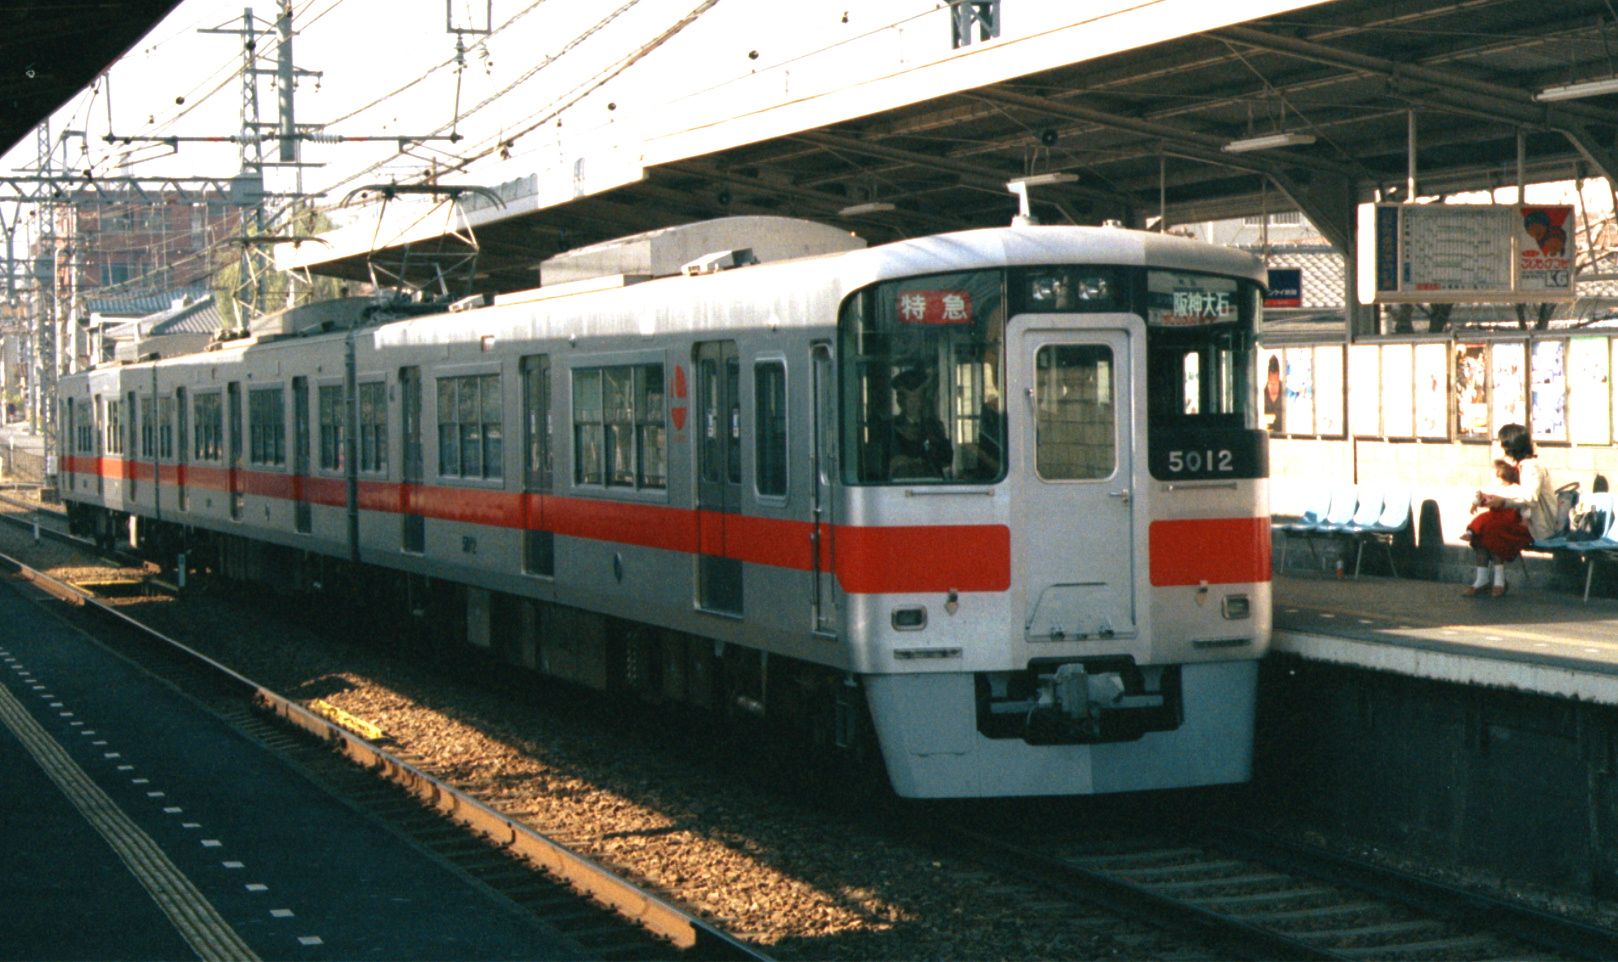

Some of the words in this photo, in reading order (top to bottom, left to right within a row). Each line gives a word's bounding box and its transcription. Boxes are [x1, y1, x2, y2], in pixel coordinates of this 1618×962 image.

[900, 294, 968, 321] 特急
[1173, 291, 1230, 317] 阪神大石
[1168, 449, 1233, 472] 5012
